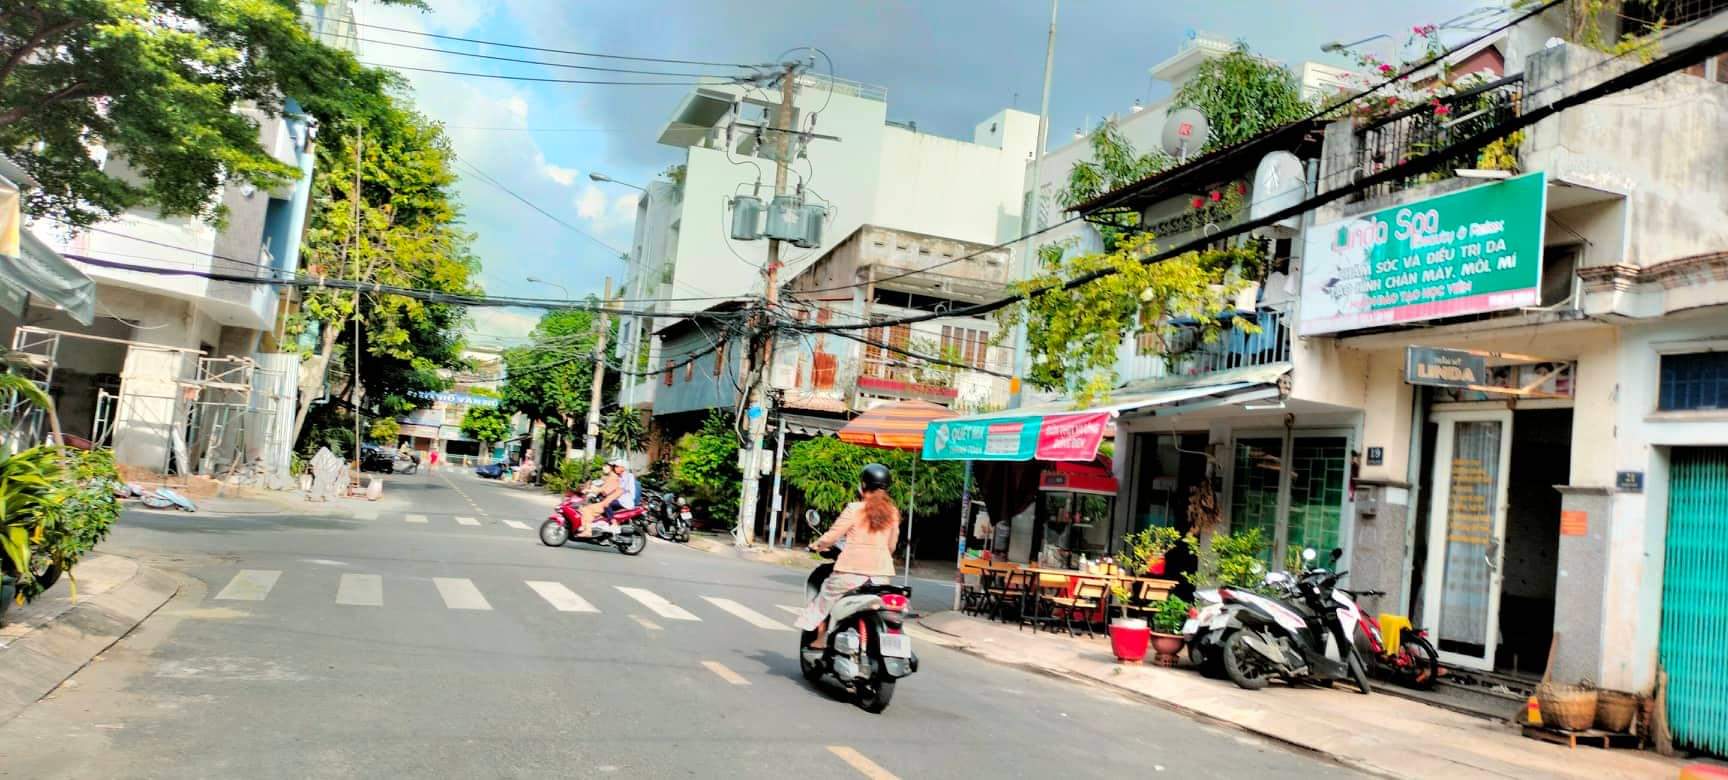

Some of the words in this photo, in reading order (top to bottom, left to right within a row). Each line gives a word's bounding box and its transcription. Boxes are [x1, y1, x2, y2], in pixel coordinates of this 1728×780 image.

[1395, 208, 1439, 249] Spa
[1460, 241, 1480, 258] TRỊ
[1486, 238, 1506, 253] DA
[1417, 362, 1476, 383] LINDA
